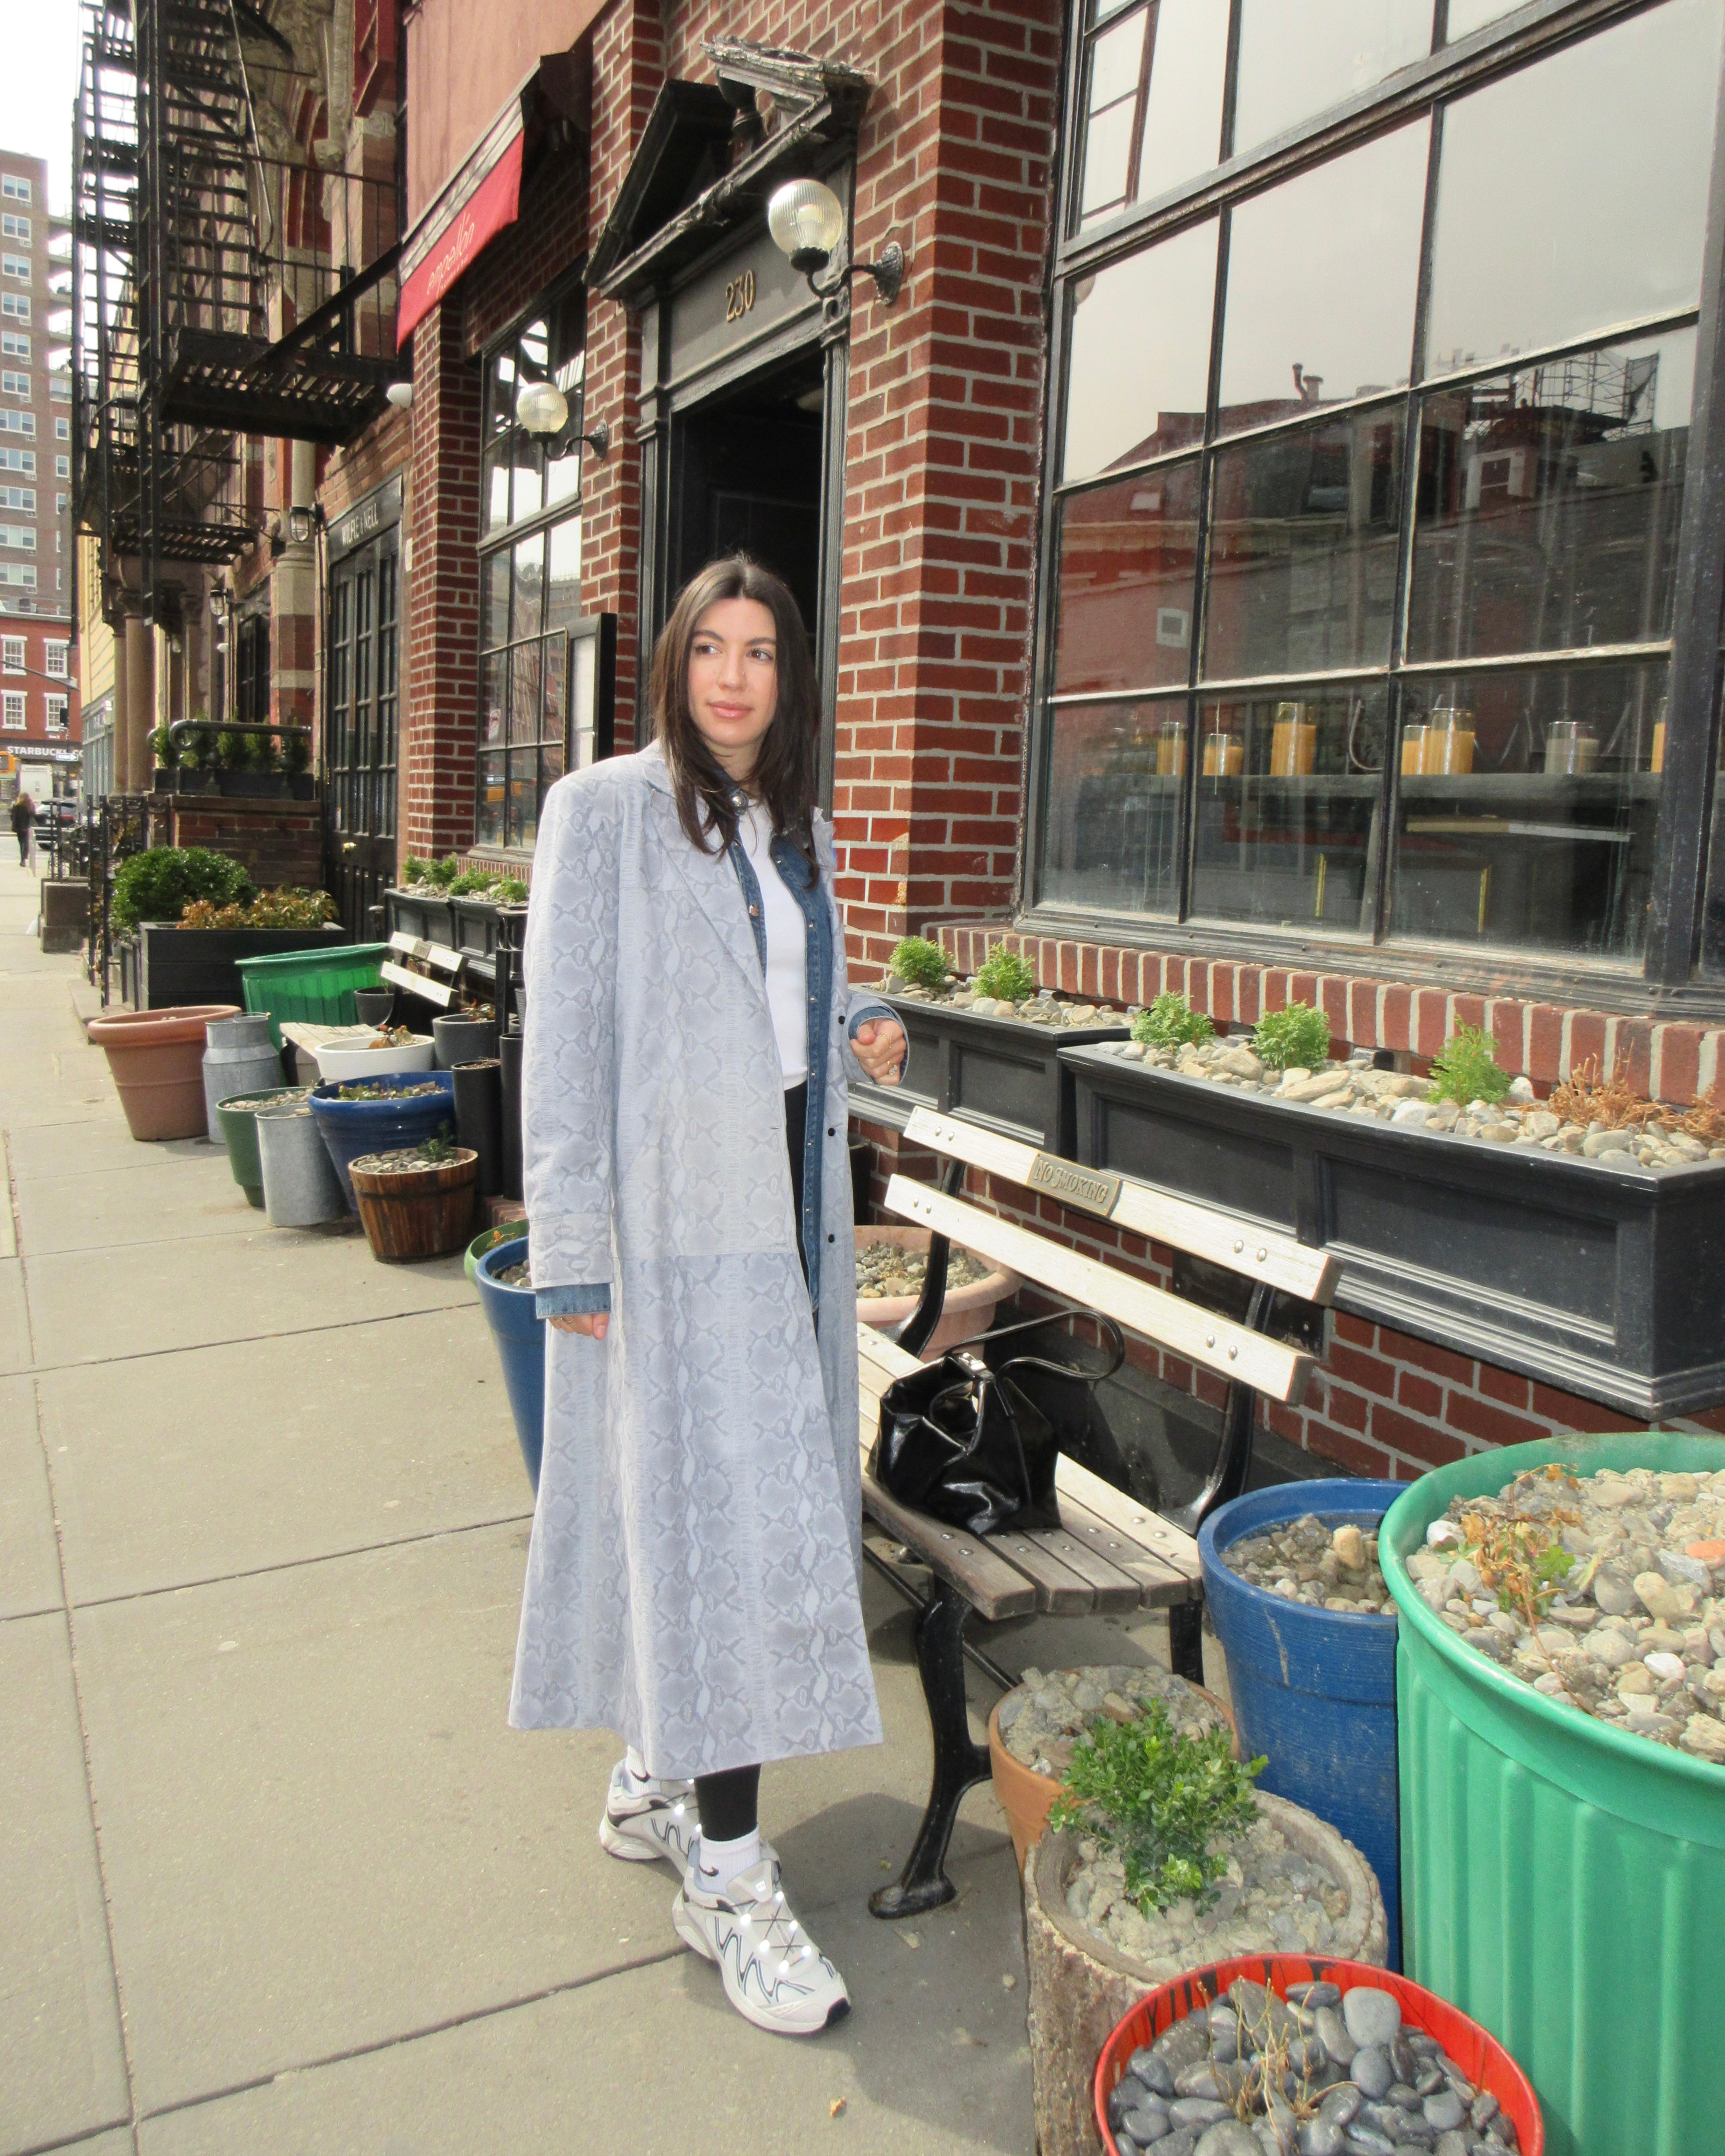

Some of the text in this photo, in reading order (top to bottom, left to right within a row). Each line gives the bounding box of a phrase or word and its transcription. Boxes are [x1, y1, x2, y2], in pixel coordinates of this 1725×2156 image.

[726, 270, 756, 321] 230
[7, 746, 67, 756] STARBUCKS
[1034, 1160, 1109, 1203] NO SMOKING
